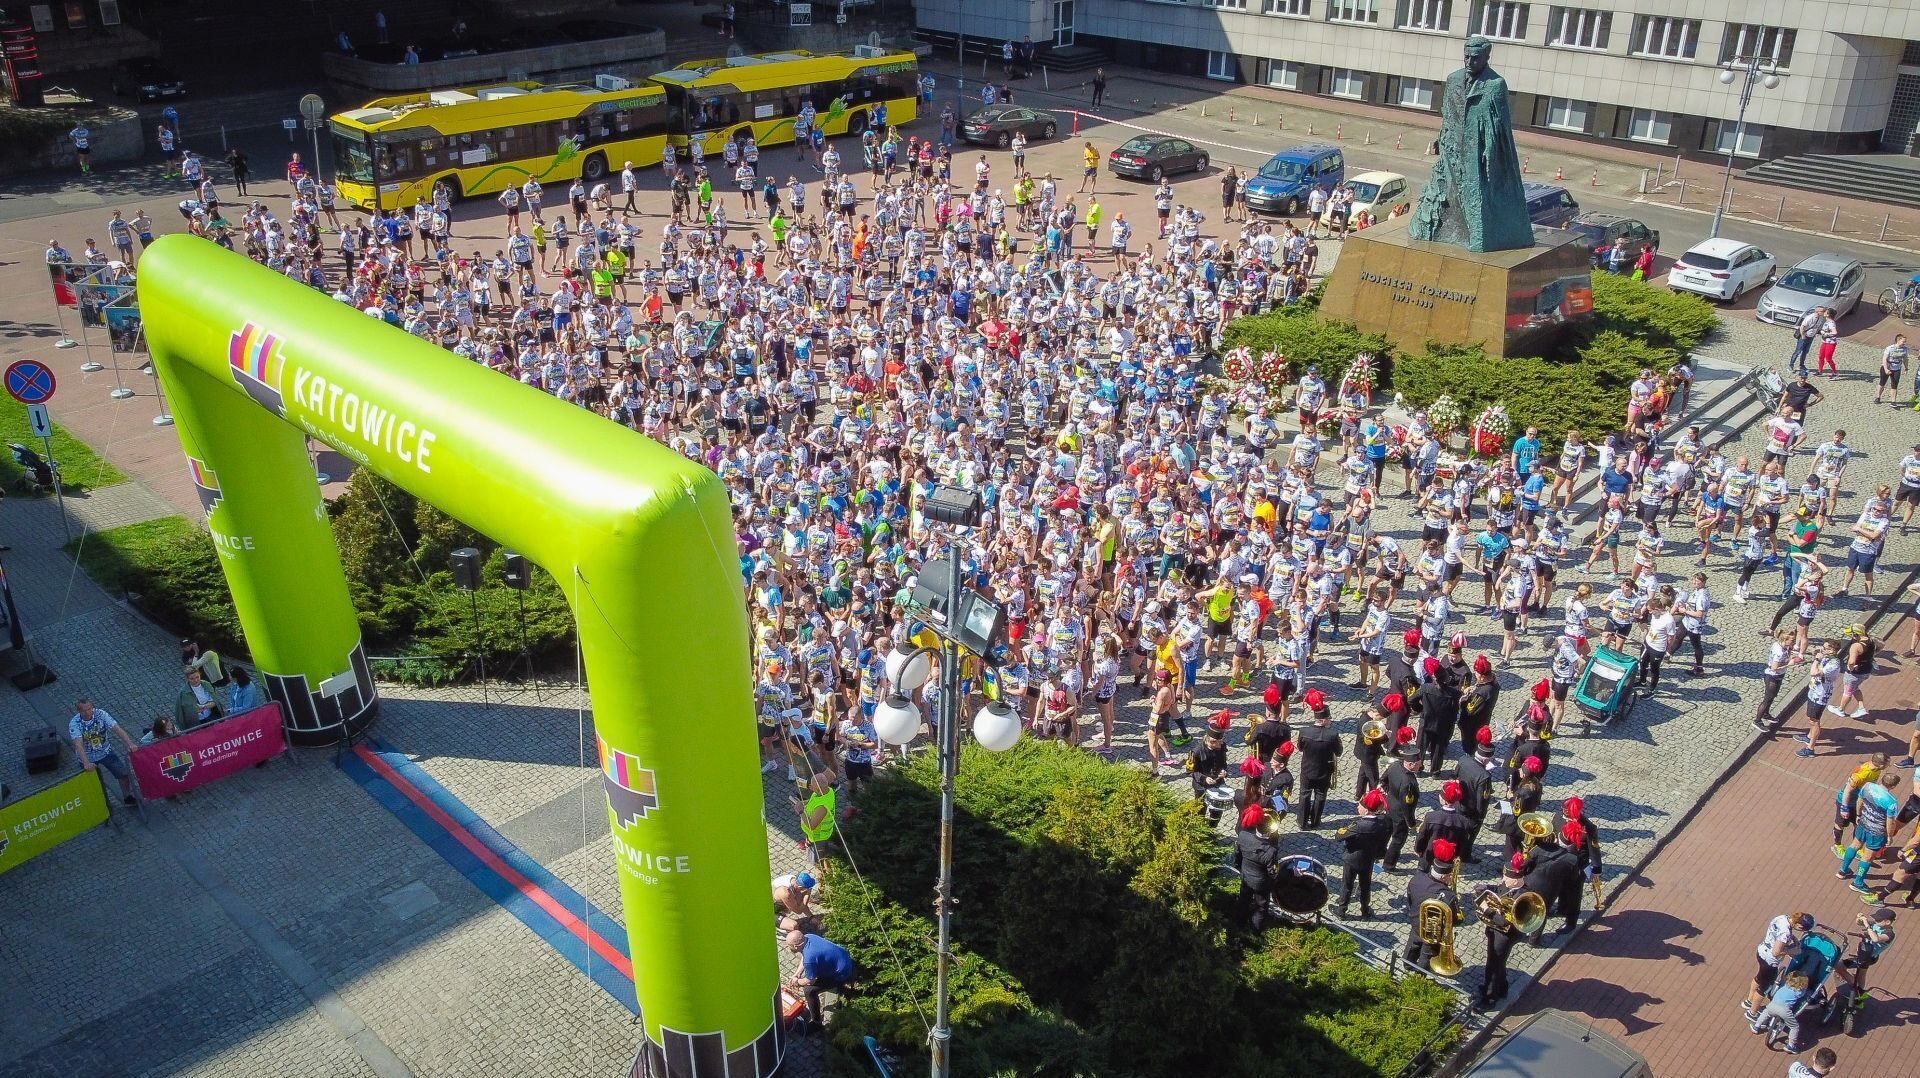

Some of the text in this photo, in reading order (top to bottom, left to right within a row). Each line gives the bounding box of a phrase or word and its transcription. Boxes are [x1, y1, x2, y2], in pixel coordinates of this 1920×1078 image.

[619, 97, 647, 108] electric
[1360, 271, 1477, 305] WOJCIECH KORFANTY
[294, 366, 437, 474] KATOWICE
[199, 728, 263, 760] KATOWICE
[213, 750, 239, 763] odmiany
[13, 797, 82, 836] KATOWICE
[624, 863, 659, 885] change
